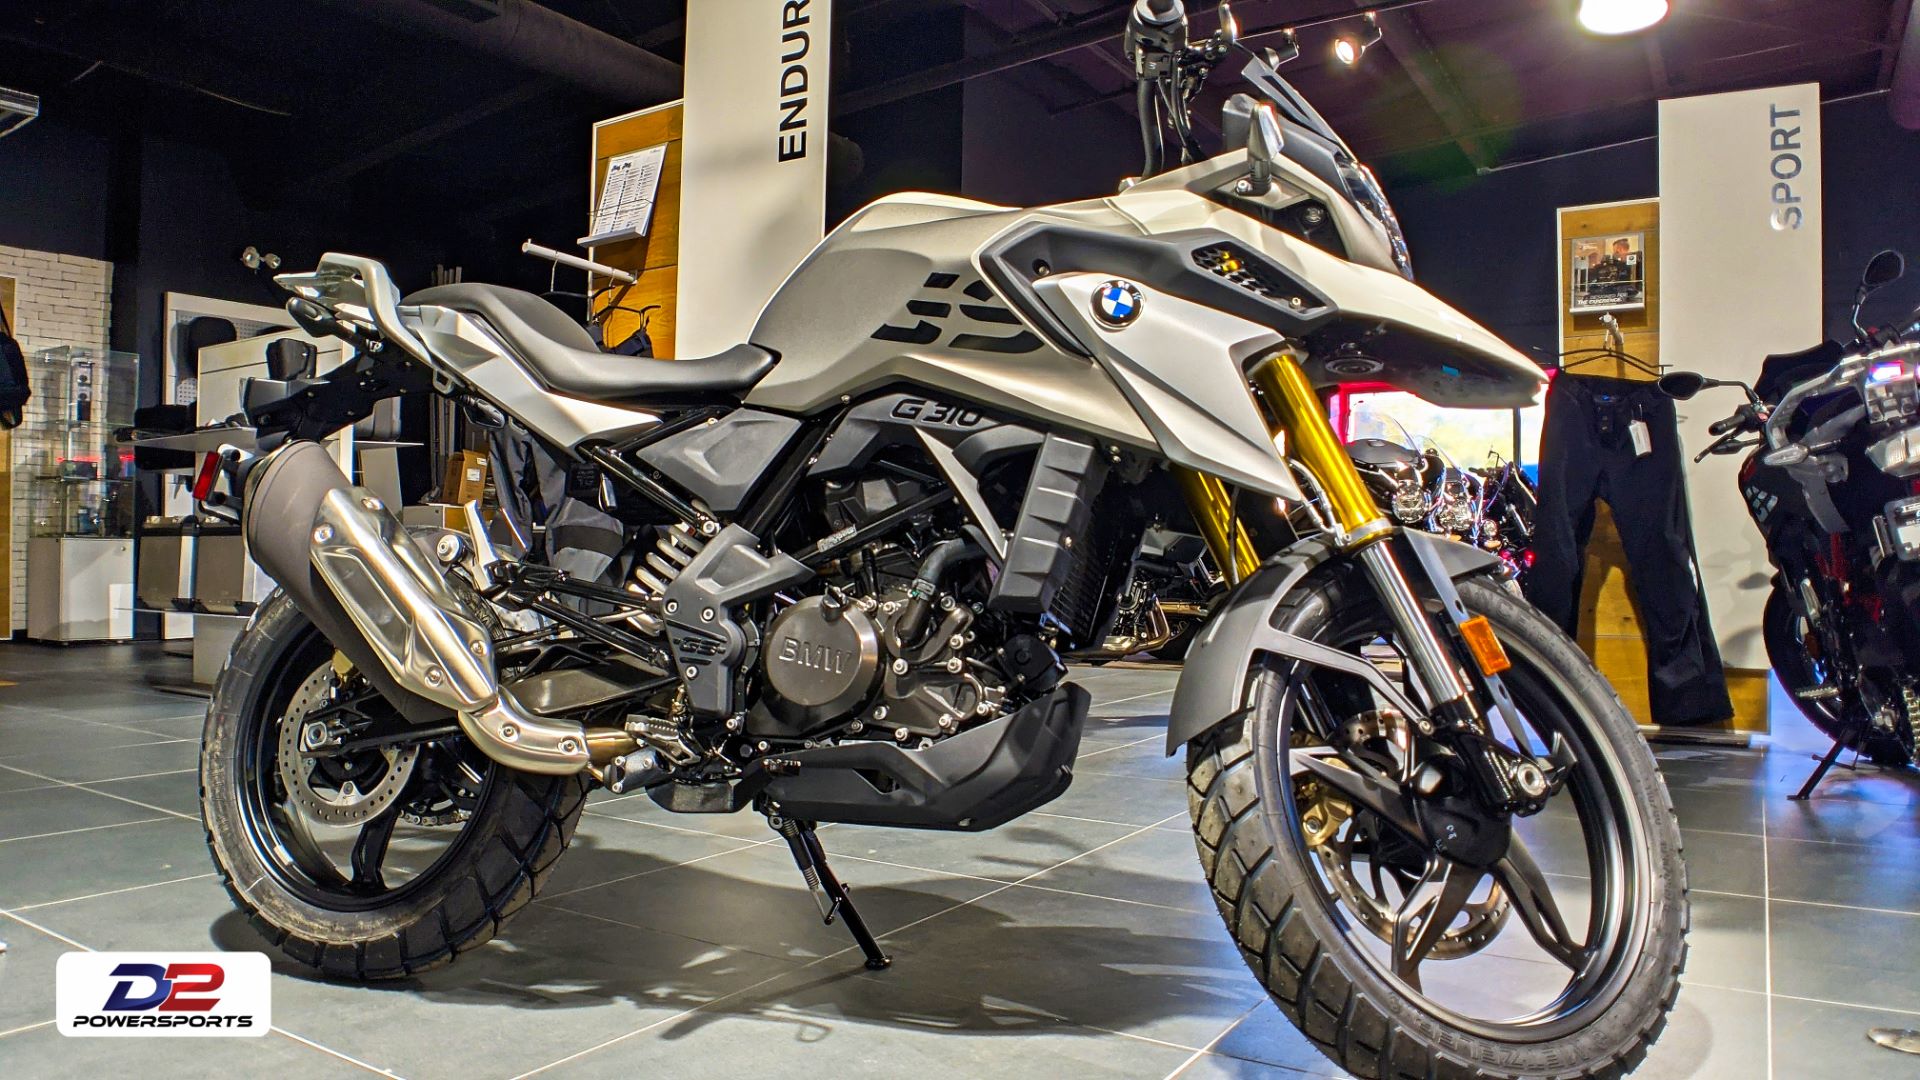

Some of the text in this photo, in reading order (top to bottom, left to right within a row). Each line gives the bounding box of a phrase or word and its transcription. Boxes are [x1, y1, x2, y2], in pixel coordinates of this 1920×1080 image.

[1769, 103, 1802, 231] SPORT
[890, 398, 984, 428] G 310
[778, 636, 854, 675] BMW
